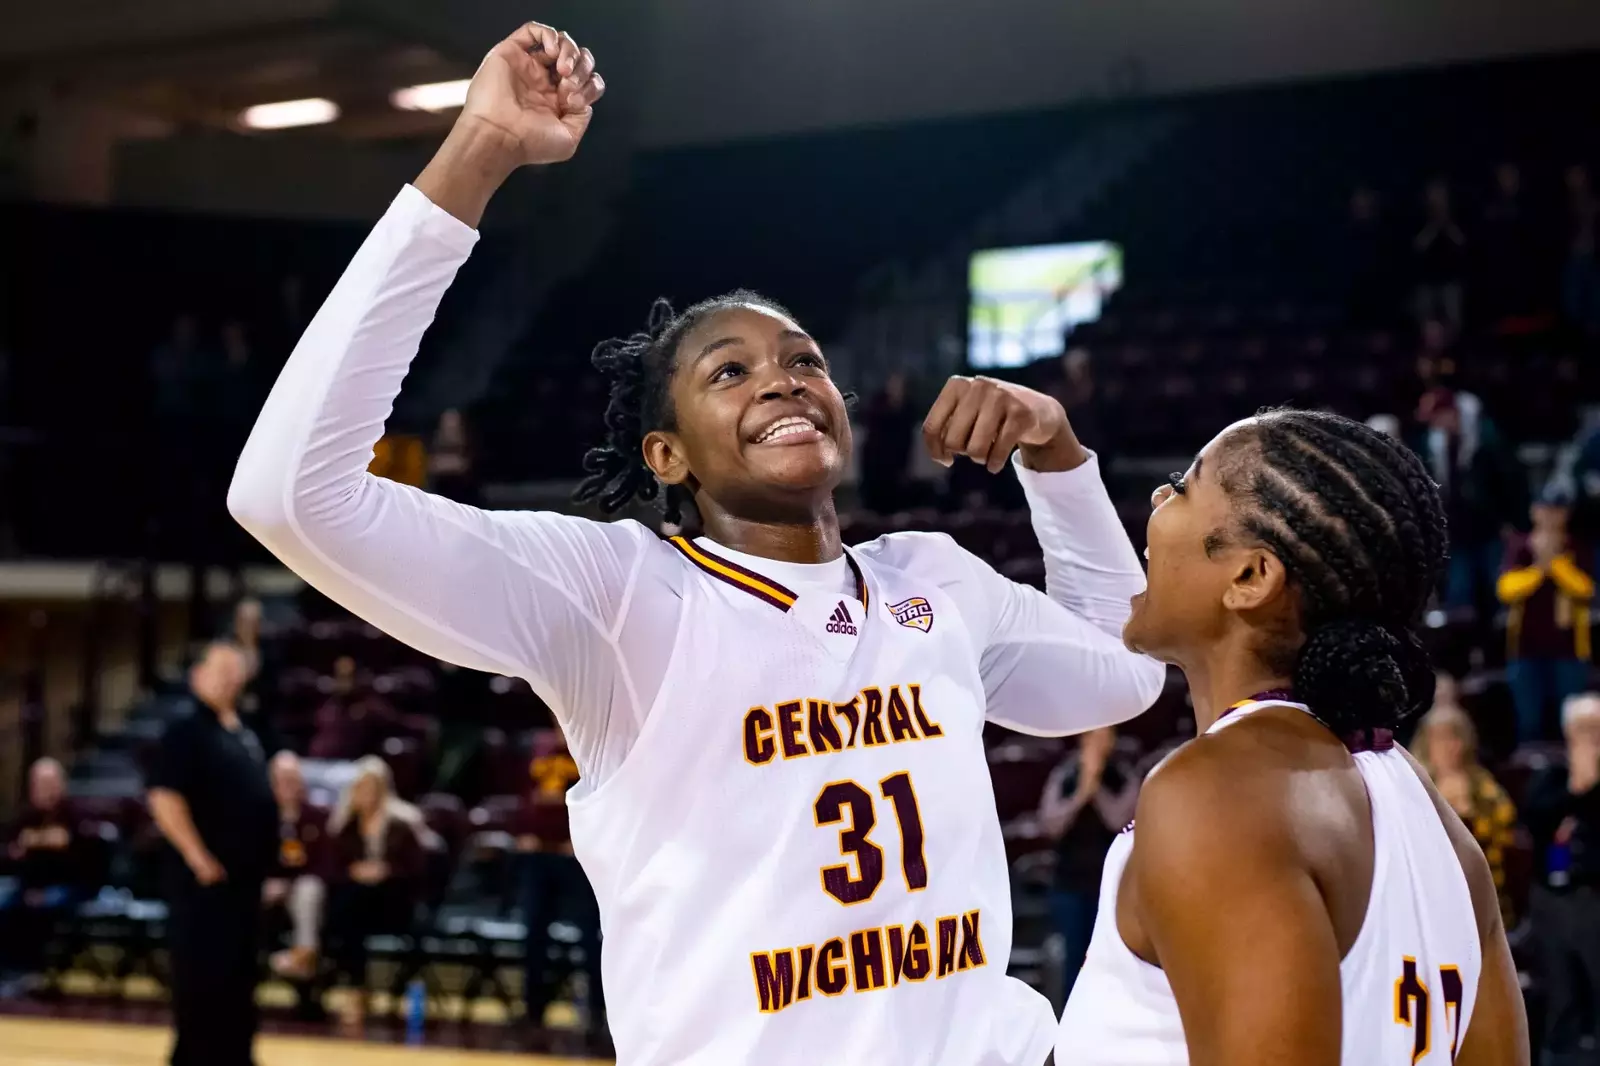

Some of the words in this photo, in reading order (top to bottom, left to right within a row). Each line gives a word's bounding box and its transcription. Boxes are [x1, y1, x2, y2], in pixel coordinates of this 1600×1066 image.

[825, 621, 858, 636] adidas
[742, 683, 945, 766] CENTRAL
[813, 769, 928, 907] 31
[750, 909, 987, 1013] MICHIGAN
